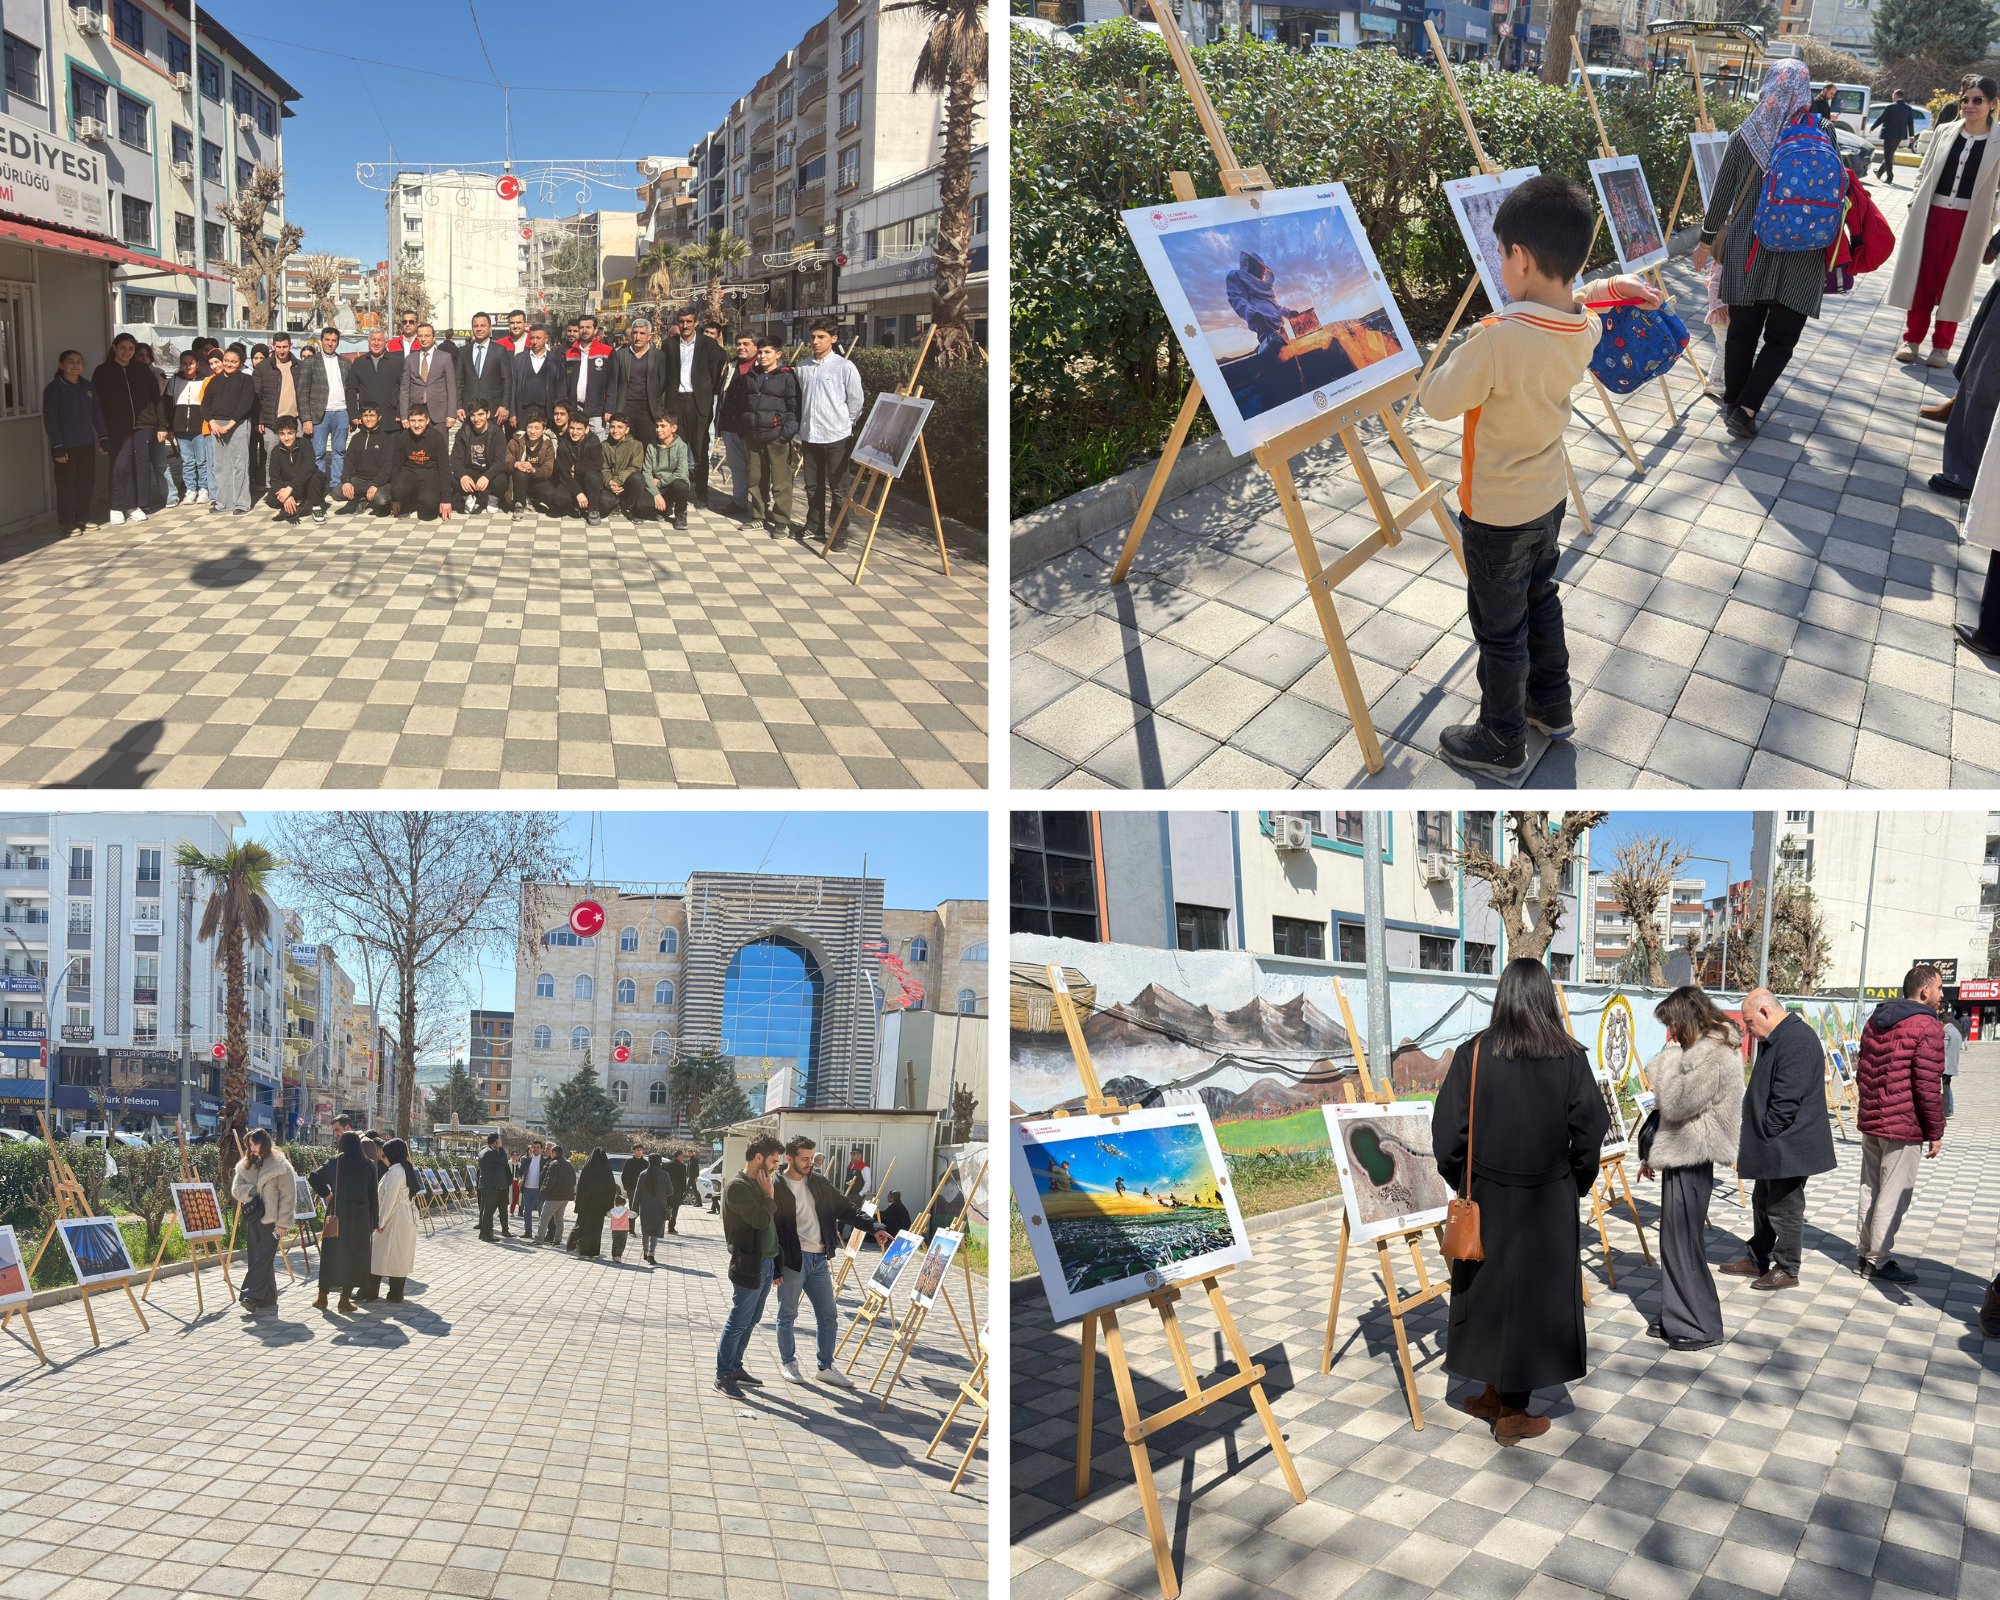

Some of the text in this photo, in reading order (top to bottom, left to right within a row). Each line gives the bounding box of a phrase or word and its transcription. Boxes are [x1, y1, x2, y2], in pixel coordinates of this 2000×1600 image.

[0, 162, 49, 192] ÜRLÜĞÜ
[17, 1029, 45, 1038] CEZERİ
[124, 1096, 160, 1106] Telekom
